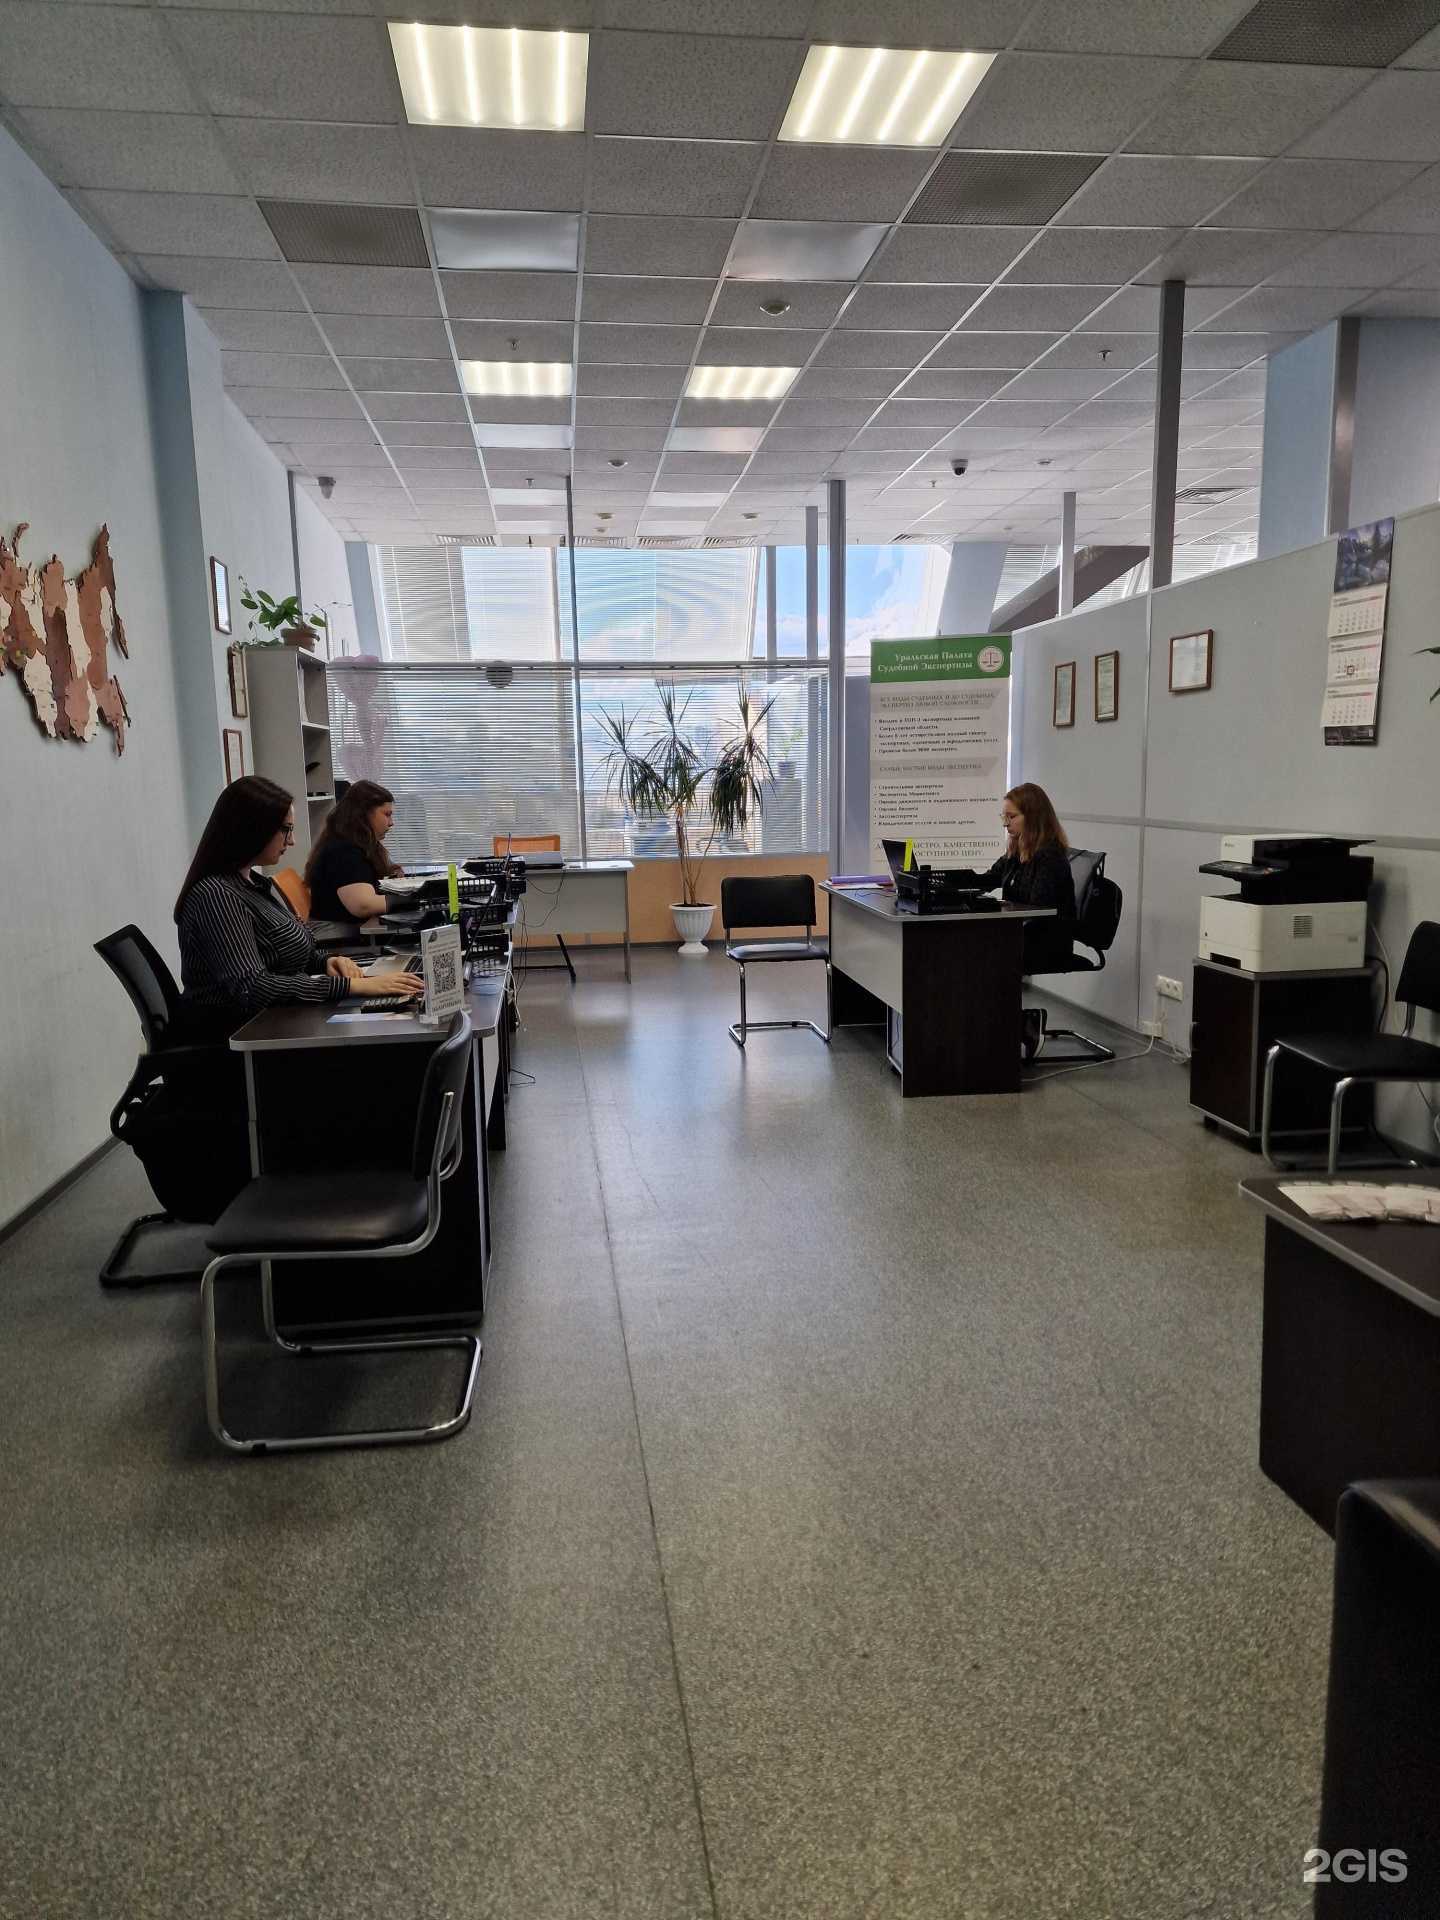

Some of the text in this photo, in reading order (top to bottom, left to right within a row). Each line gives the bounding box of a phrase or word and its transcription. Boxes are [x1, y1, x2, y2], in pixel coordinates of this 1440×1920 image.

[895, 651, 973, 662] Уральская Палата
[878, 662, 973, 672] Судебной Экспертизы
[913, 849, 960, 857] ОСТУПНУЮ
